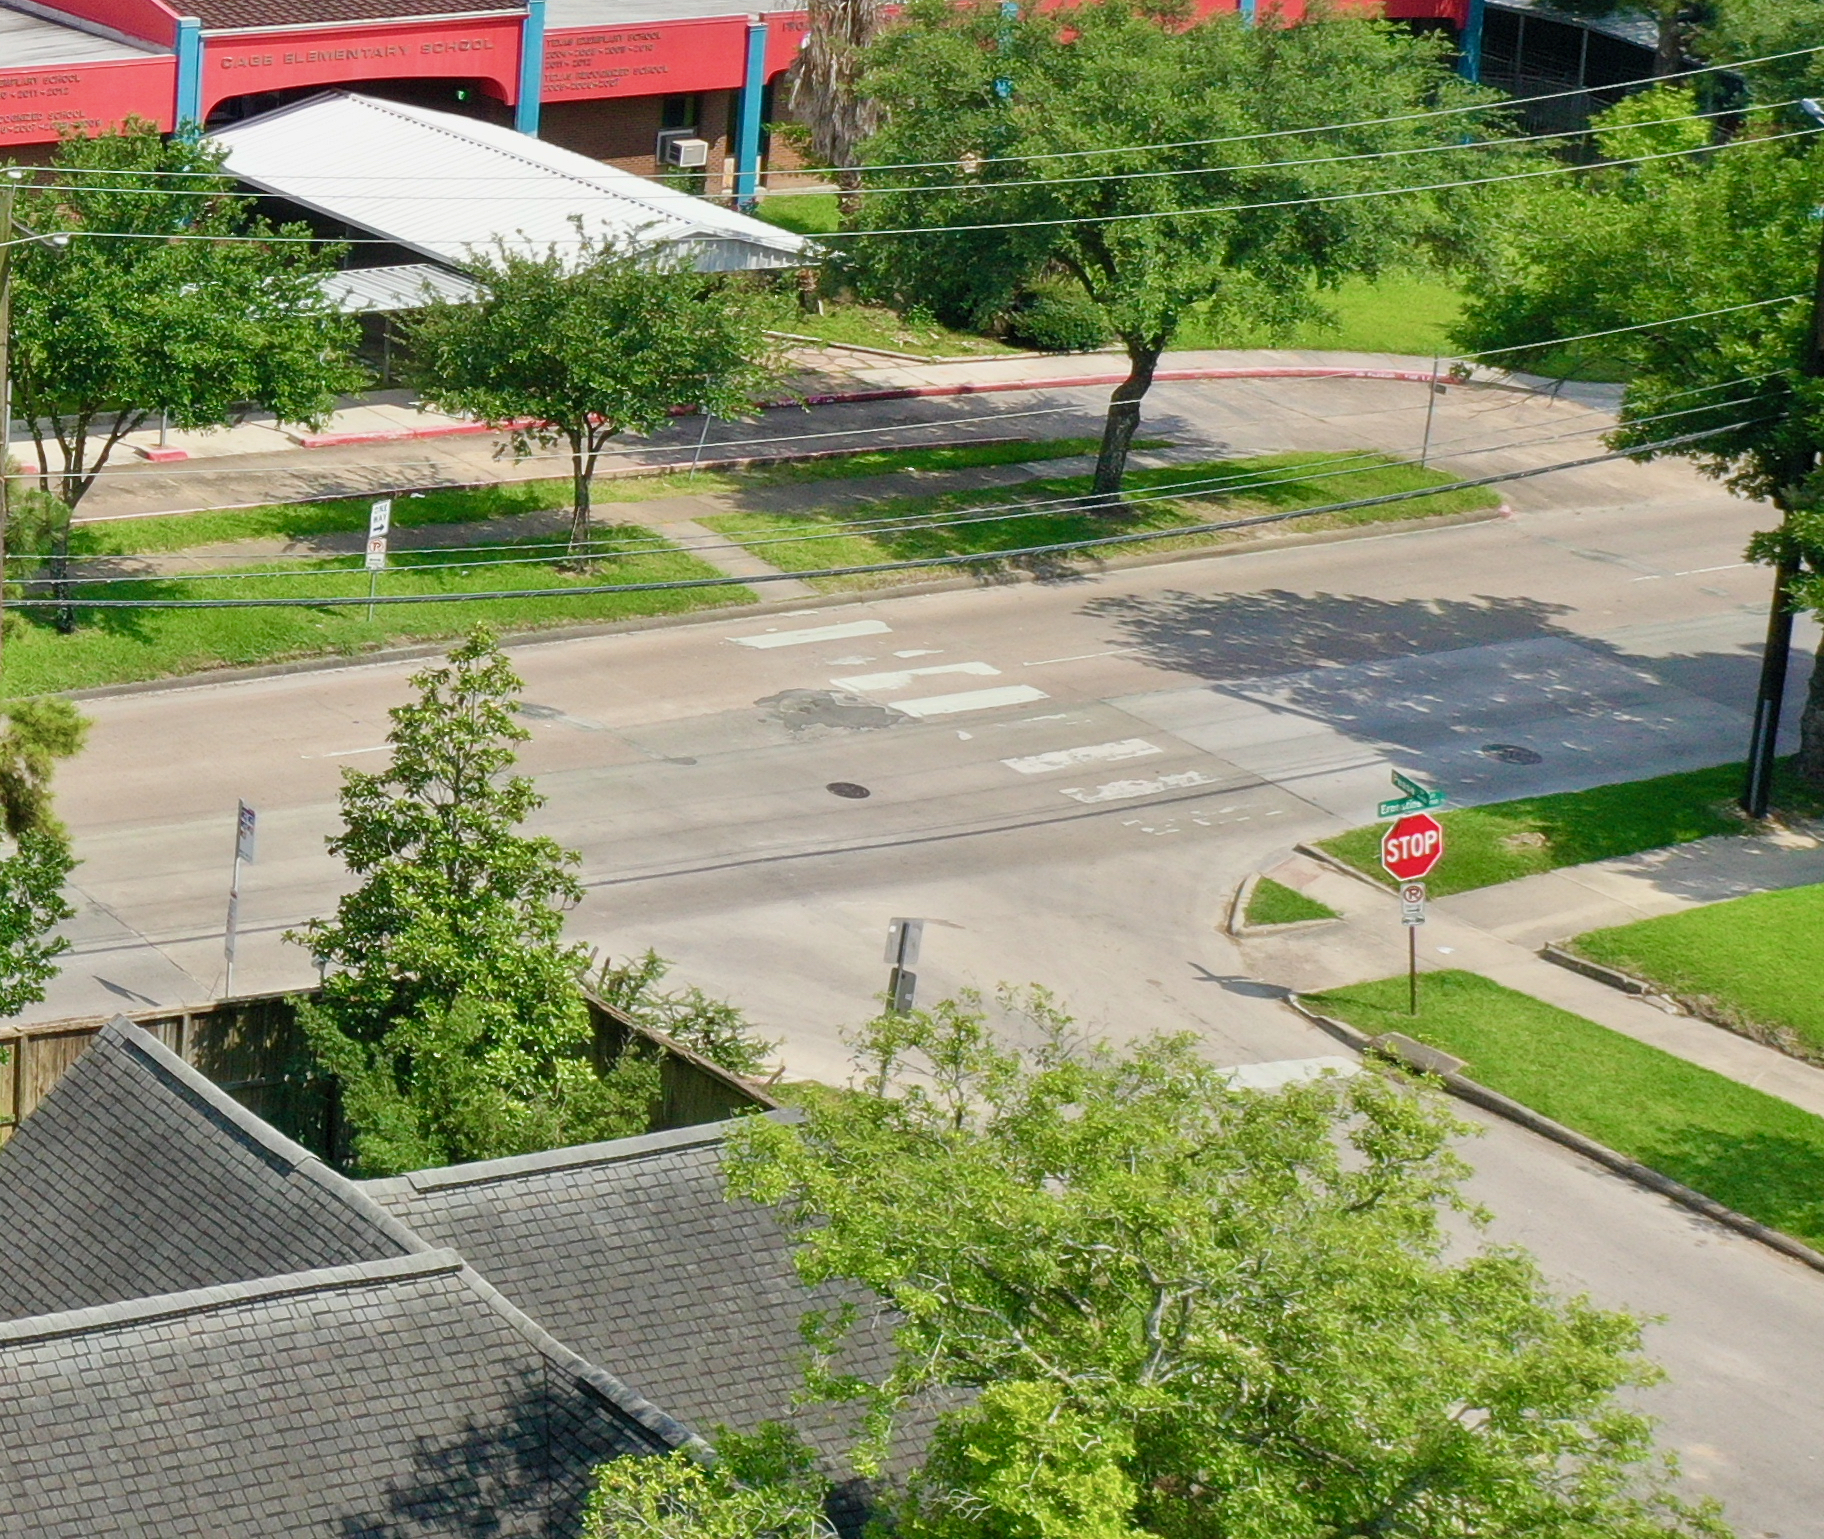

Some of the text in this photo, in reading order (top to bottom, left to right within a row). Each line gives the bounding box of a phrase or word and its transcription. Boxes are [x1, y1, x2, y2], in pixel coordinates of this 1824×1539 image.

[627, 31, 661, 41] SCHOOL
[220, 39, 495, 70] CAGE ELEMENTARY SCHOOL
[632, 65, 669, 76] SCHOOL
[42, 73, 81, 85] SCHOOL
[47, 109, 85, 121] SCHOOL
[1386, 830, 1438, 863] STOP
